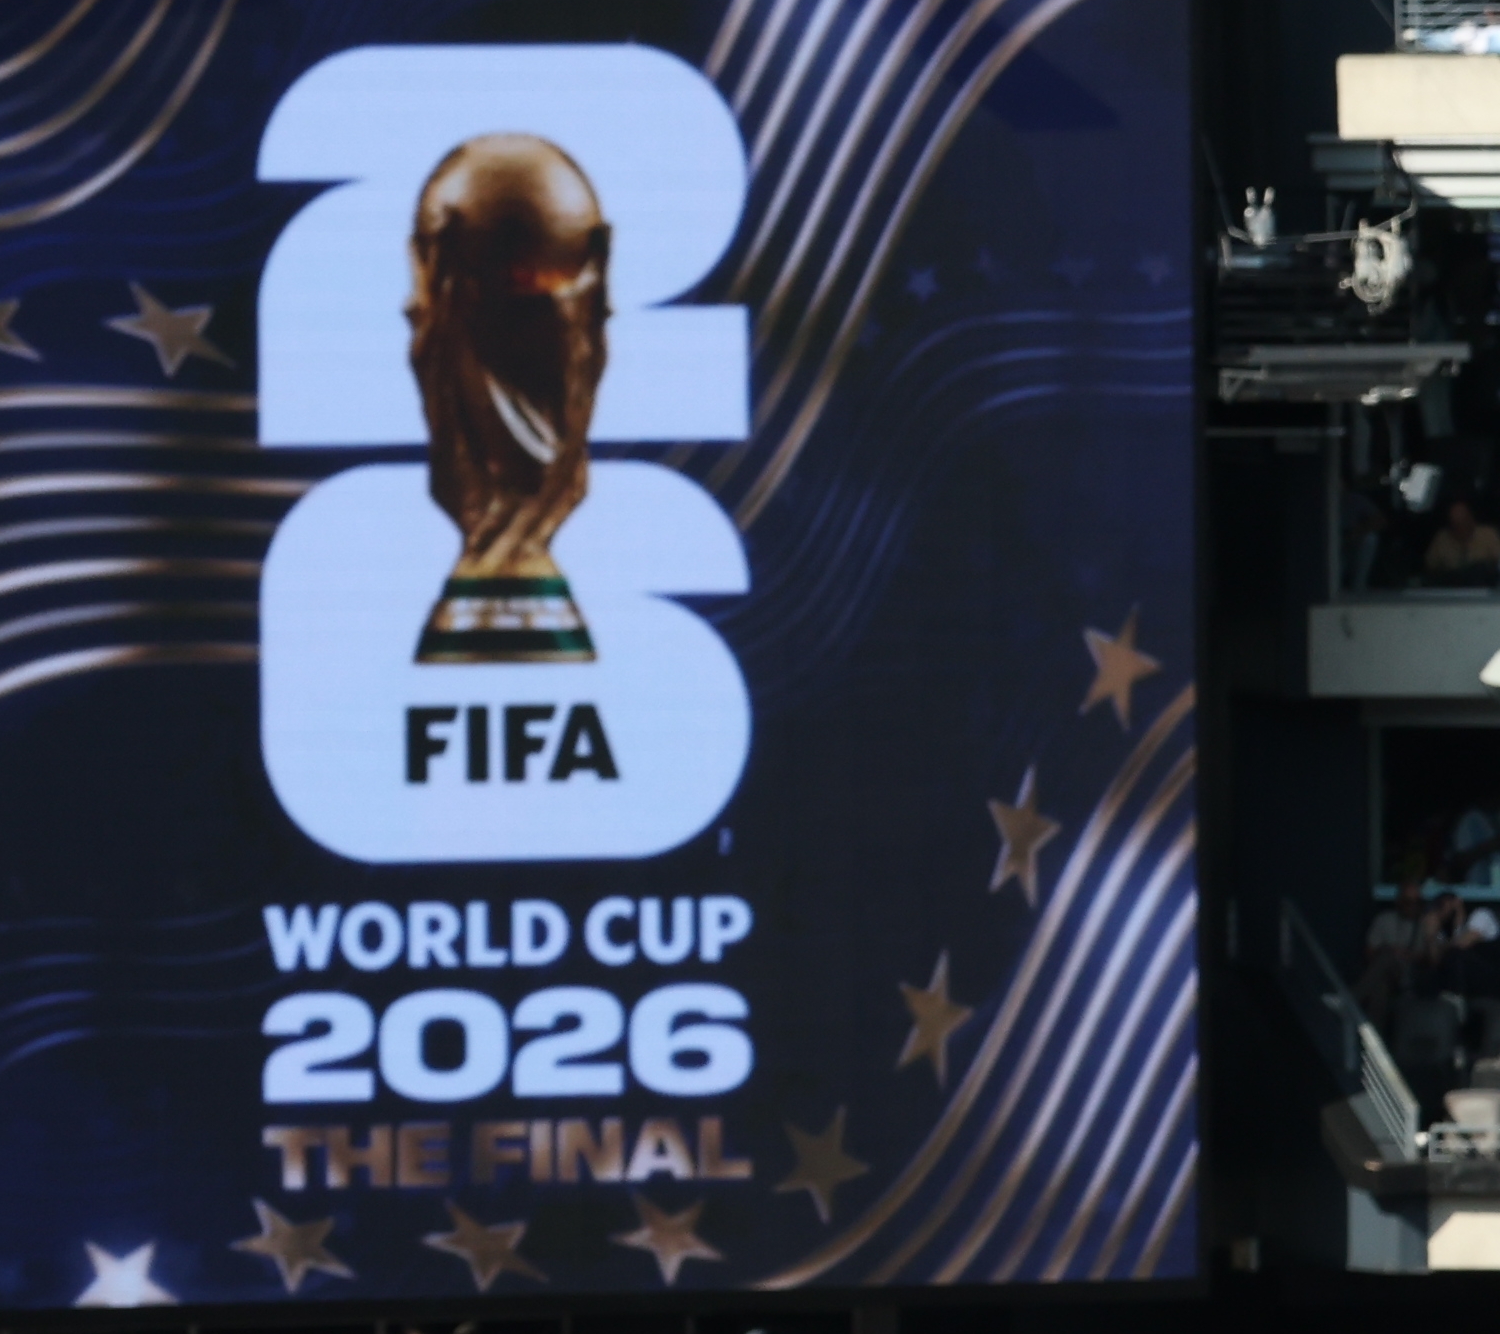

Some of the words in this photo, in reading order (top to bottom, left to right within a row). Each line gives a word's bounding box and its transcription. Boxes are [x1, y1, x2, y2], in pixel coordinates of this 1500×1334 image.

[406, 704, 619, 783] FIFA
[265, 901, 568, 970] WORLD
[585, 897, 751, 966] CUP
[263, 984, 751, 1104] 2026
[261, 1125, 450, 1192] THE
[472, 1117, 753, 1185] FINAL
